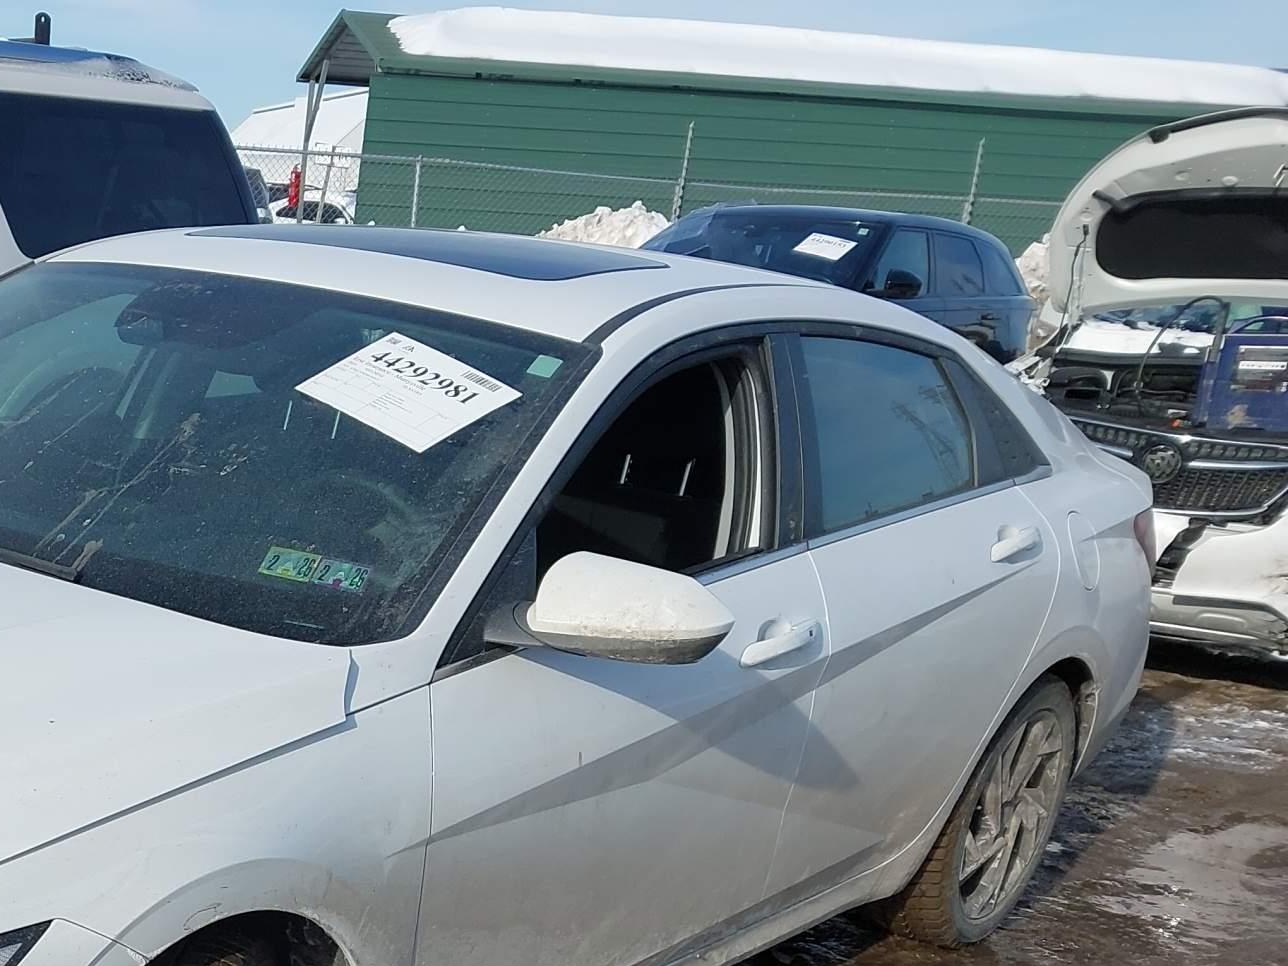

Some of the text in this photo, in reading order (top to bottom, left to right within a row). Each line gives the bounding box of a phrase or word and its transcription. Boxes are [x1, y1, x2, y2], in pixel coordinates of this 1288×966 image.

[370, 351, 480, 405] 44292981
[265, 554, 316, 579] 2 26
[317, 564, 369, 589] 2 26
